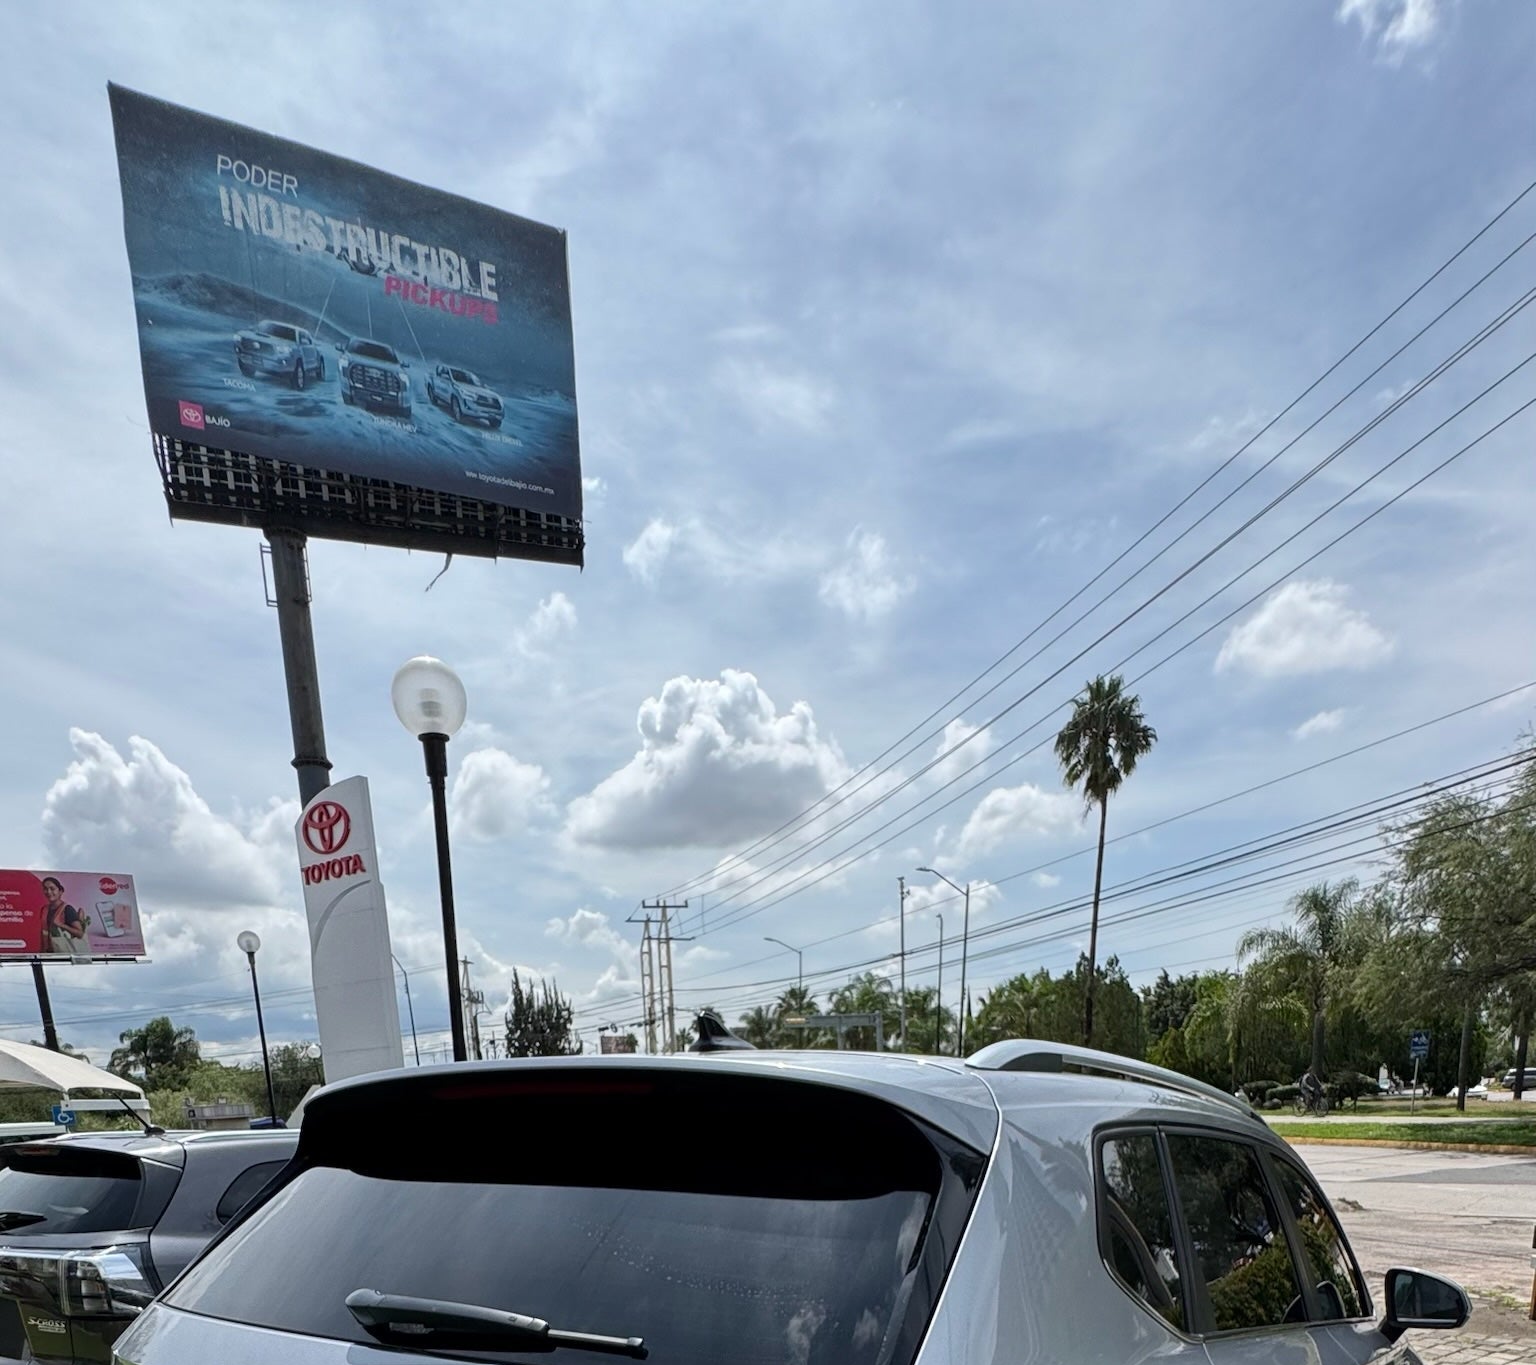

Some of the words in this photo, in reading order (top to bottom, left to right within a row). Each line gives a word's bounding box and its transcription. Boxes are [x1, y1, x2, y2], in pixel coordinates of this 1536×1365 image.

[216, 154, 298, 199] PODER
[218, 184, 499, 302] INDESTRUCTIBLE
[384, 274, 498, 324] PICKUPS
[223, 377, 257, 393] TACOMA
[205, 414, 231, 428] BAJÍO
[301, 854, 367, 886] TOYOTA
